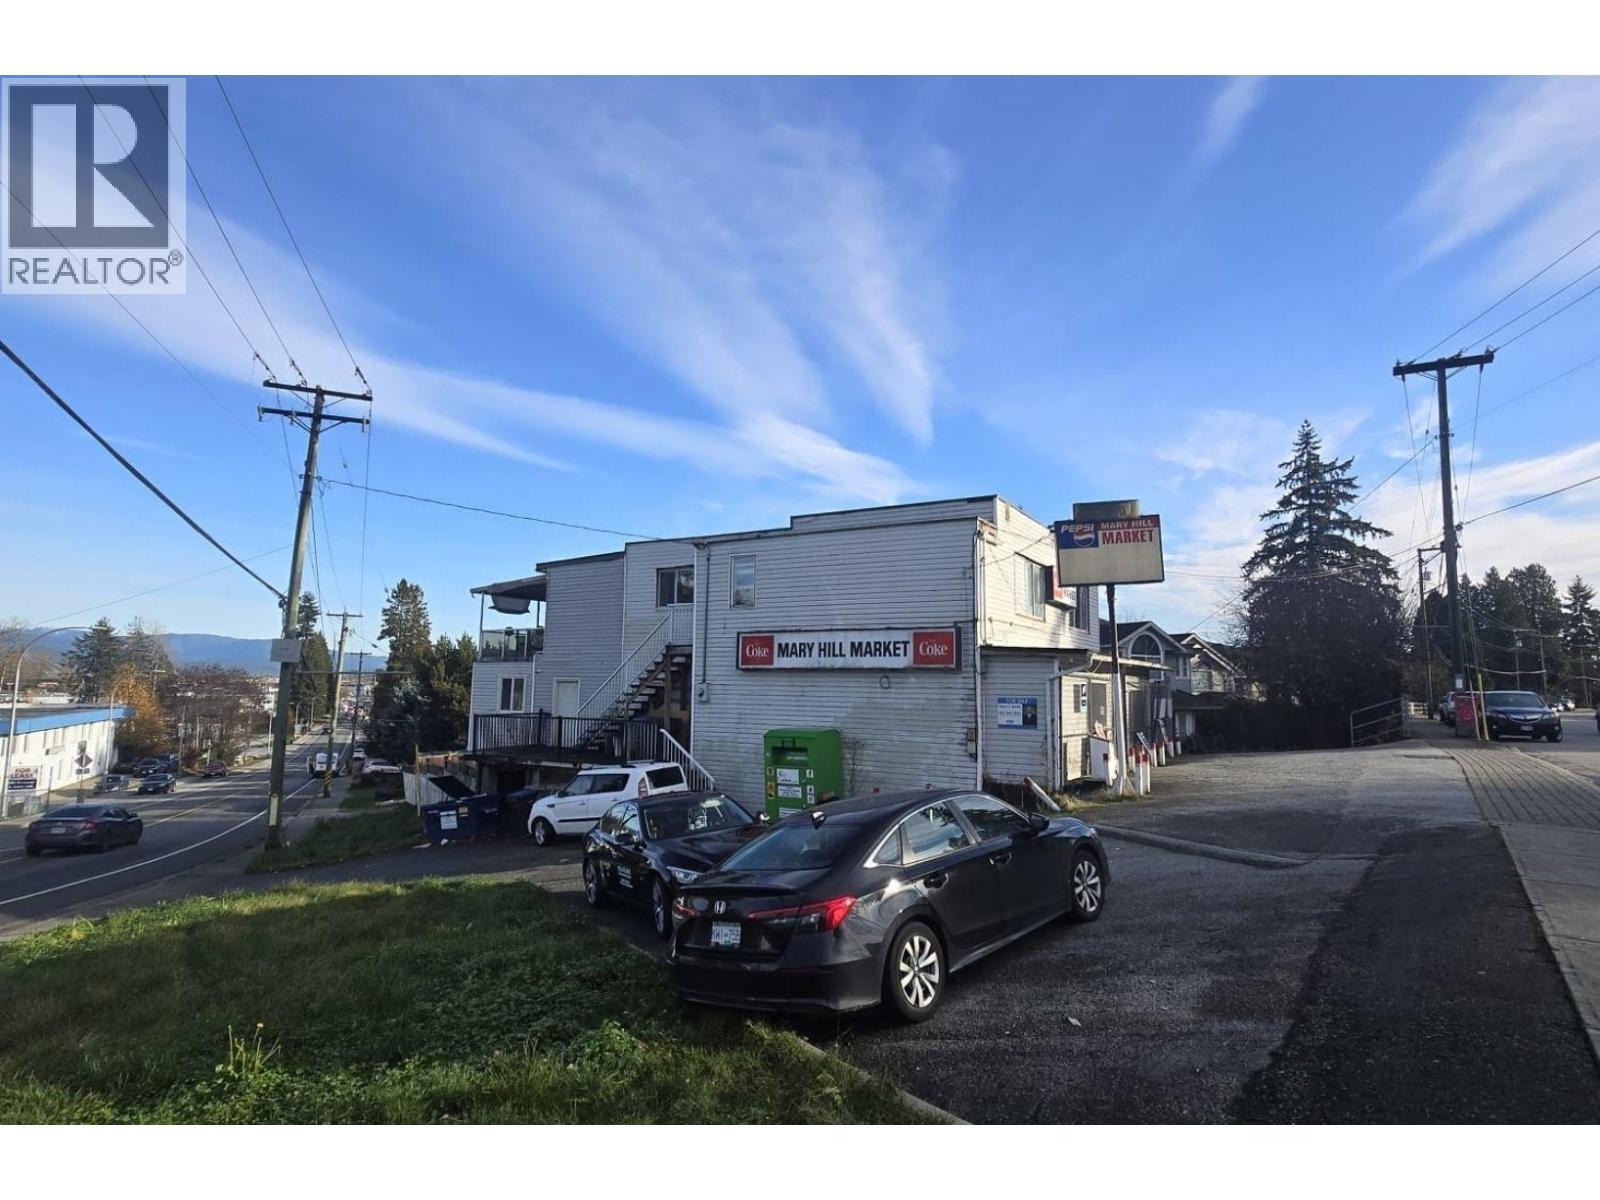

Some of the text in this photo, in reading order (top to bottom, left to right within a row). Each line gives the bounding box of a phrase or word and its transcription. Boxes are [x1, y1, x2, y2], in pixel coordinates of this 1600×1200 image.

[1060, 523, 1095, 533] PEPSI
[1101, 520, 1153, 530] MARY HILL
[1102, 530, 1154, 544] MARKET
[745, 643, 769, 657] Coke
[777, 640, 910, 658] MARY HILL MARKET
[919, 640, 949, 656] Coke
